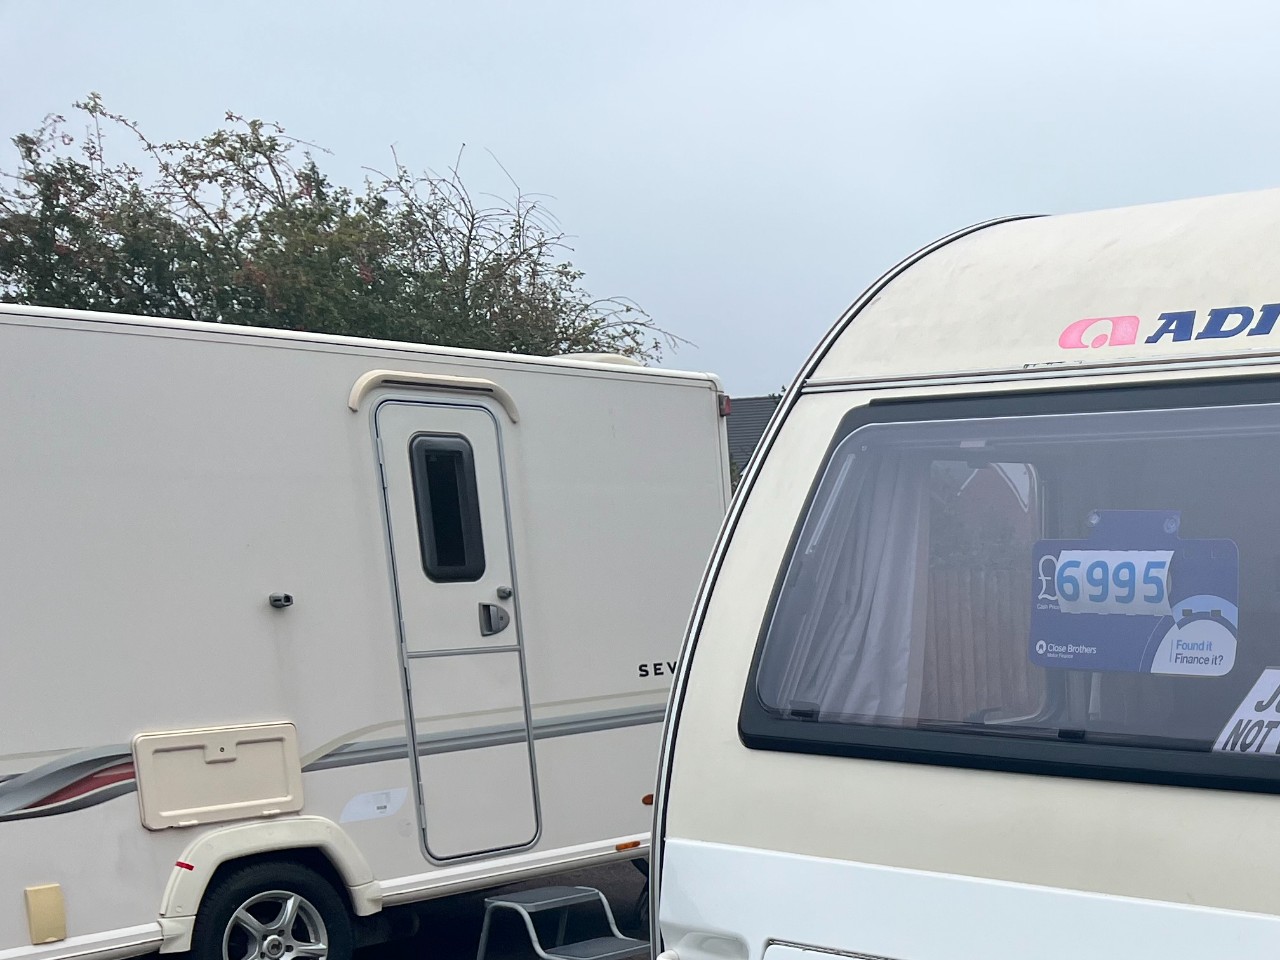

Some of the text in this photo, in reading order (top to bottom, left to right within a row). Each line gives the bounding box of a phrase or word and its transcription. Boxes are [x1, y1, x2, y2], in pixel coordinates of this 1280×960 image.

[1047, 643, 1097, 654] Close Brothers
[1176, 639, 1213, 651] Found it
[1174, 653, 1224, 666] Finance it?
